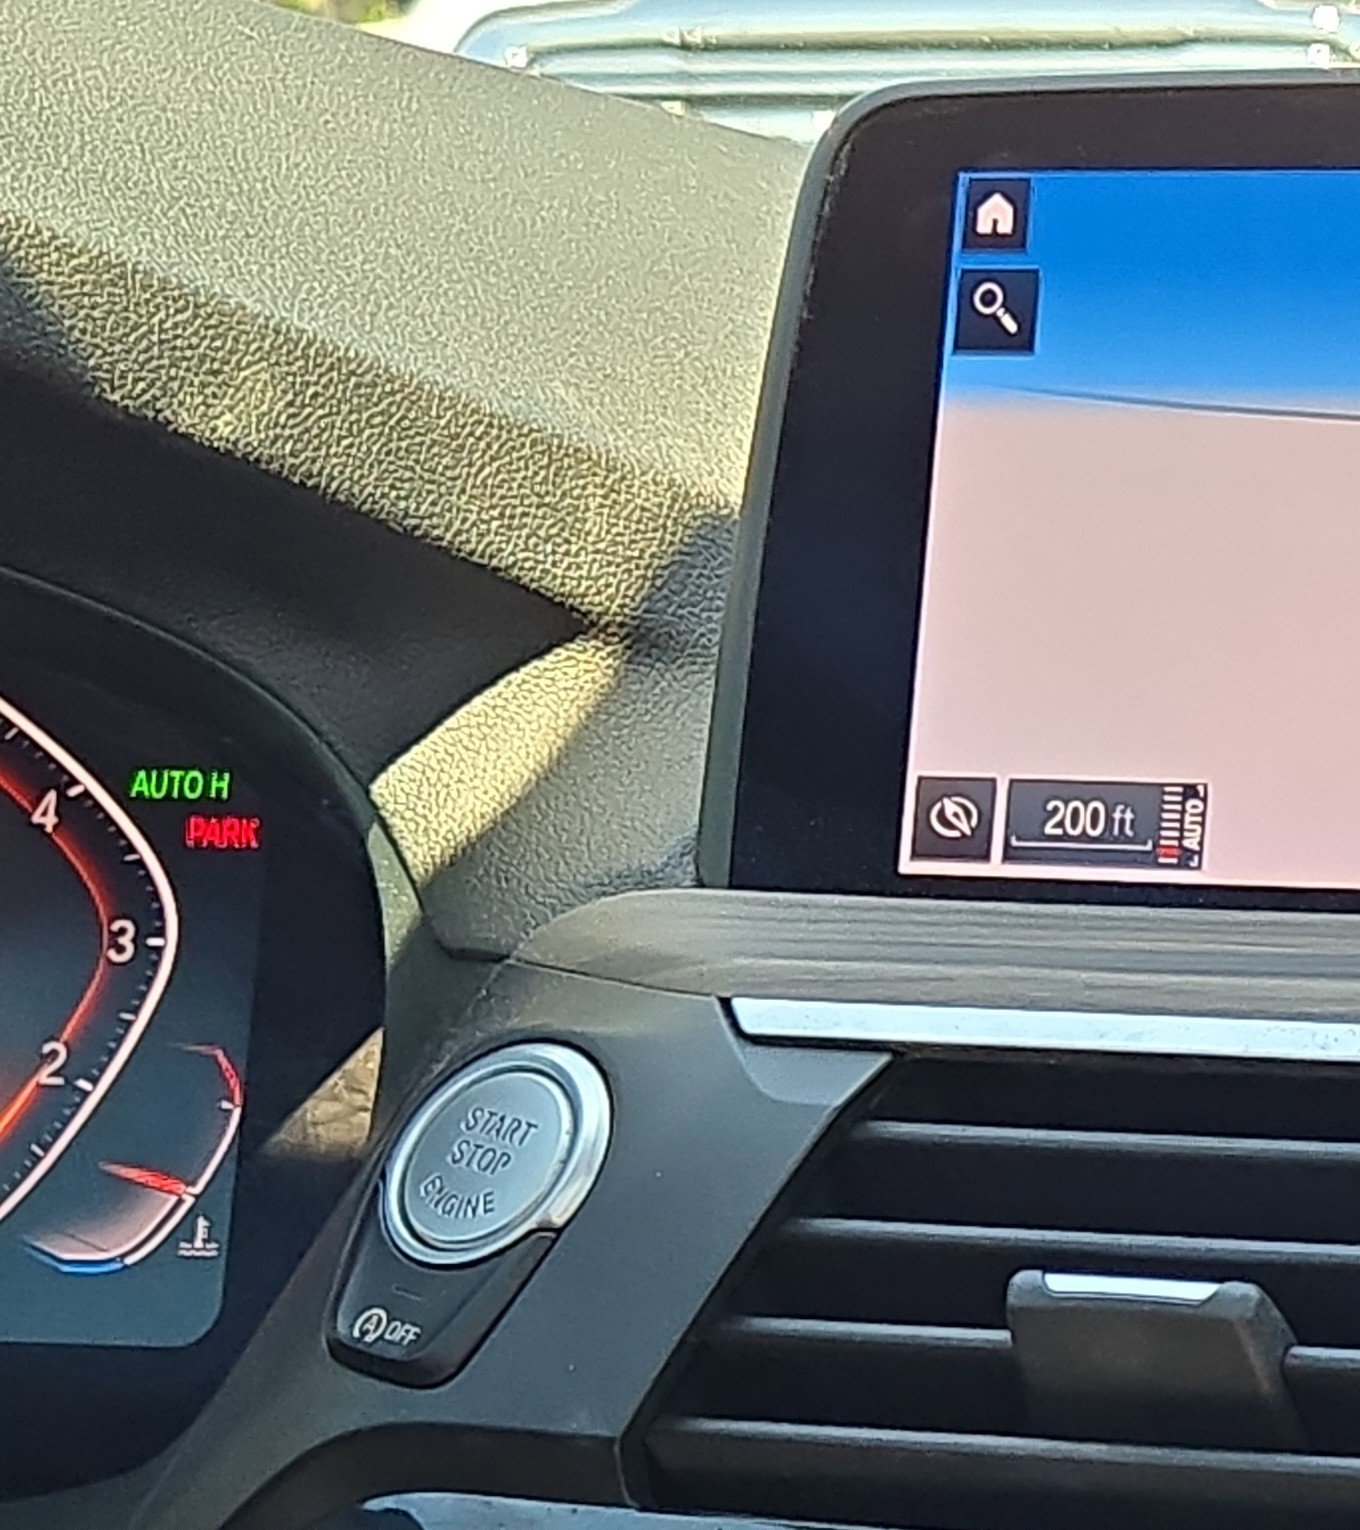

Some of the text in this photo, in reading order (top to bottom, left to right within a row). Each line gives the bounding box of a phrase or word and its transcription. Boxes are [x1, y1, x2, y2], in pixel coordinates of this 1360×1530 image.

[130, 768, 231, 800] AUTO H
[31, 790, 59, 832] 4
[1044, 800, 1135, 837] 200 ft
[1182, 798, 1205, 851] AUTO
[185, 815, 260, 849] PARK
[106, 919, 136, 963] 3
[41, 1042, 69, 1085] 2
[464, 1106, 538, 1146] START
[449, 1140, 512, 1175] STOP
[420, 1175, 496, 1219] ENGINE
[384, 1320, 422, 1346] OFF
